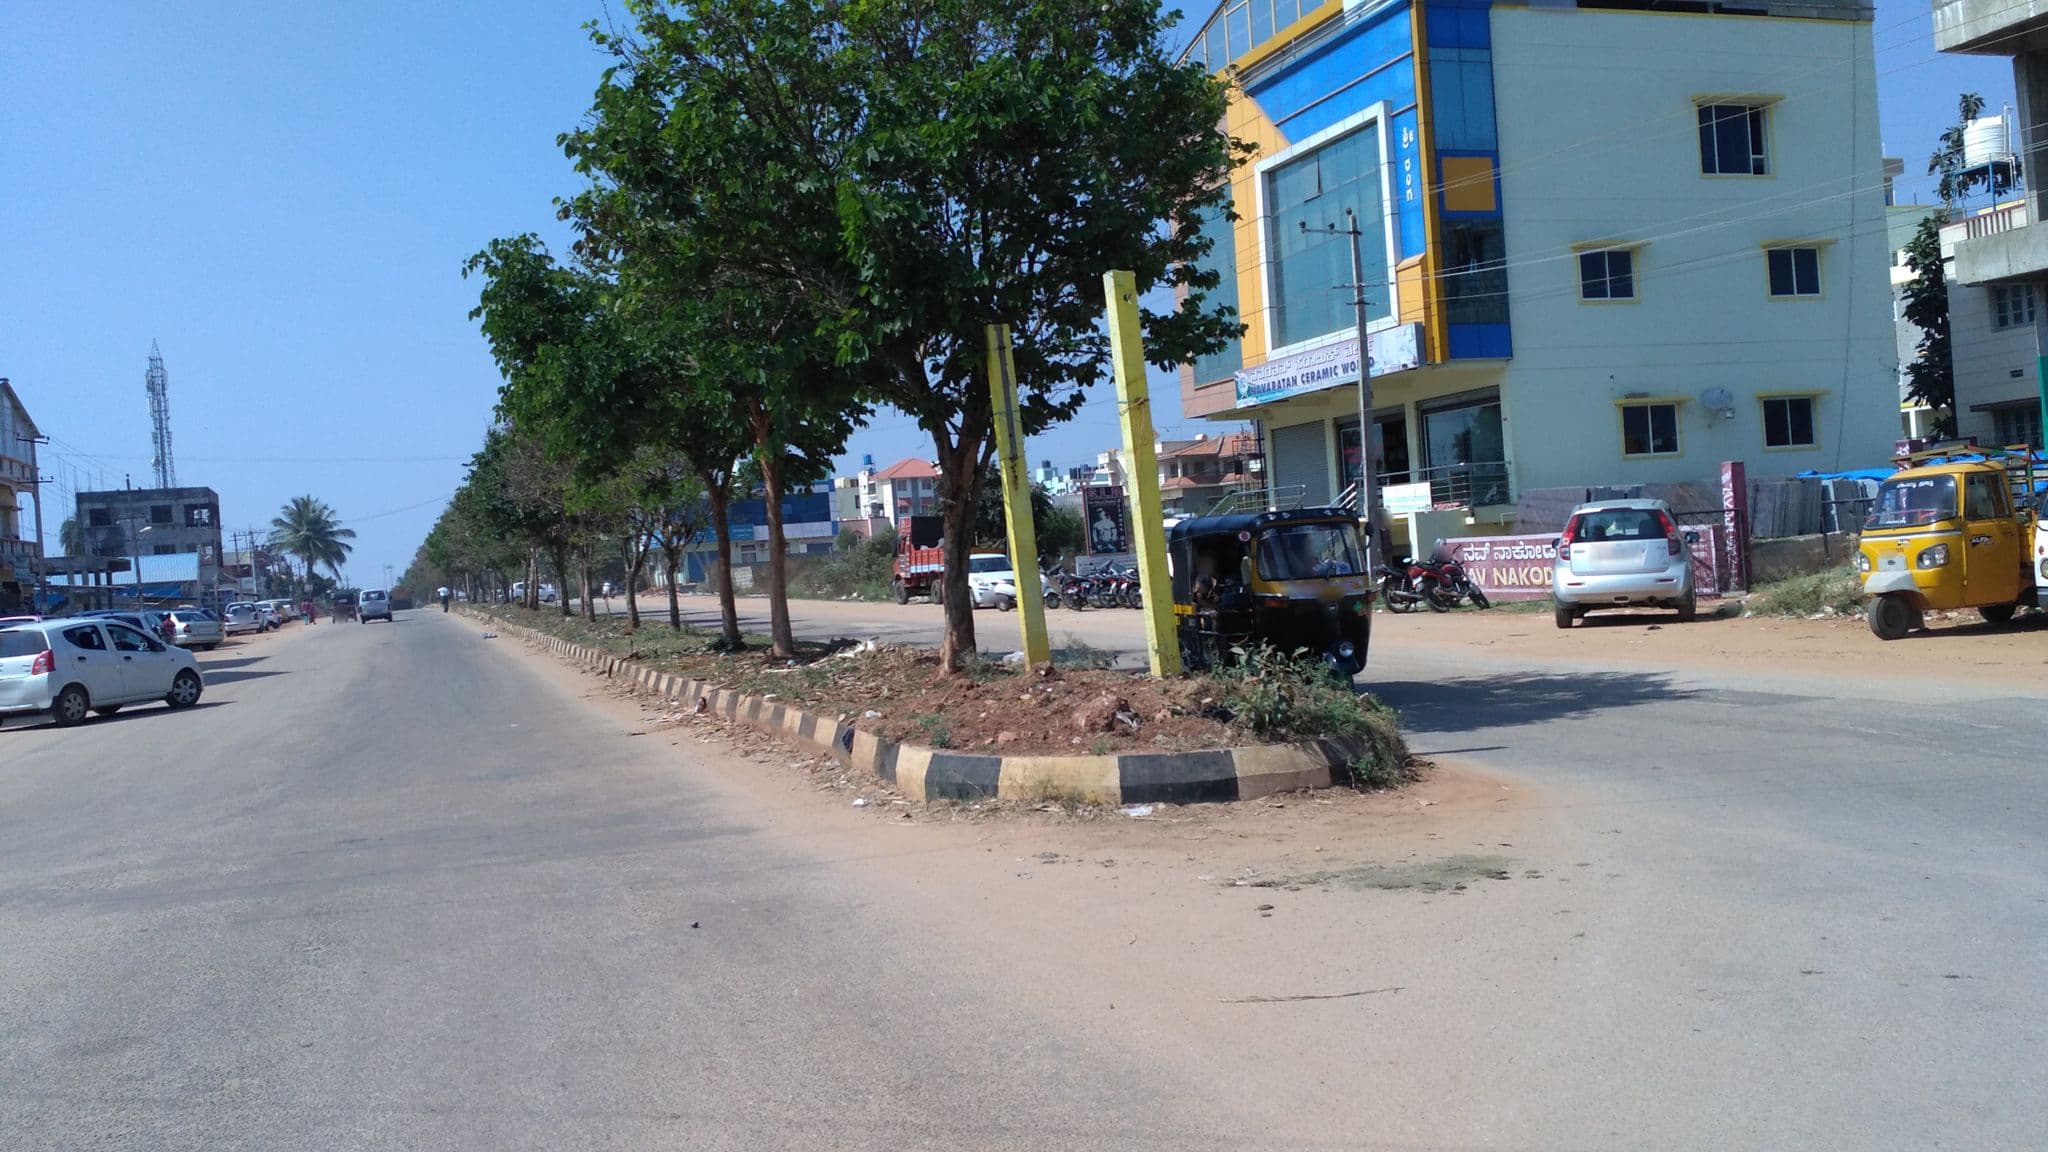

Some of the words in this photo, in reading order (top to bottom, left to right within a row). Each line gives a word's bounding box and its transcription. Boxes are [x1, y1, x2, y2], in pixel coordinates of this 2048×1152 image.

[1251, 375, 1298, 395] NAVARATAN
[1300, 365, 1338, 385] CERAMIC
[1341, 356, 1375, 375] WOD
[1462, 542, 1490, 561] ನವ್
[1464, 567, 1486, 586] AV
[1493, 566, 1553, 586] NAKOD
